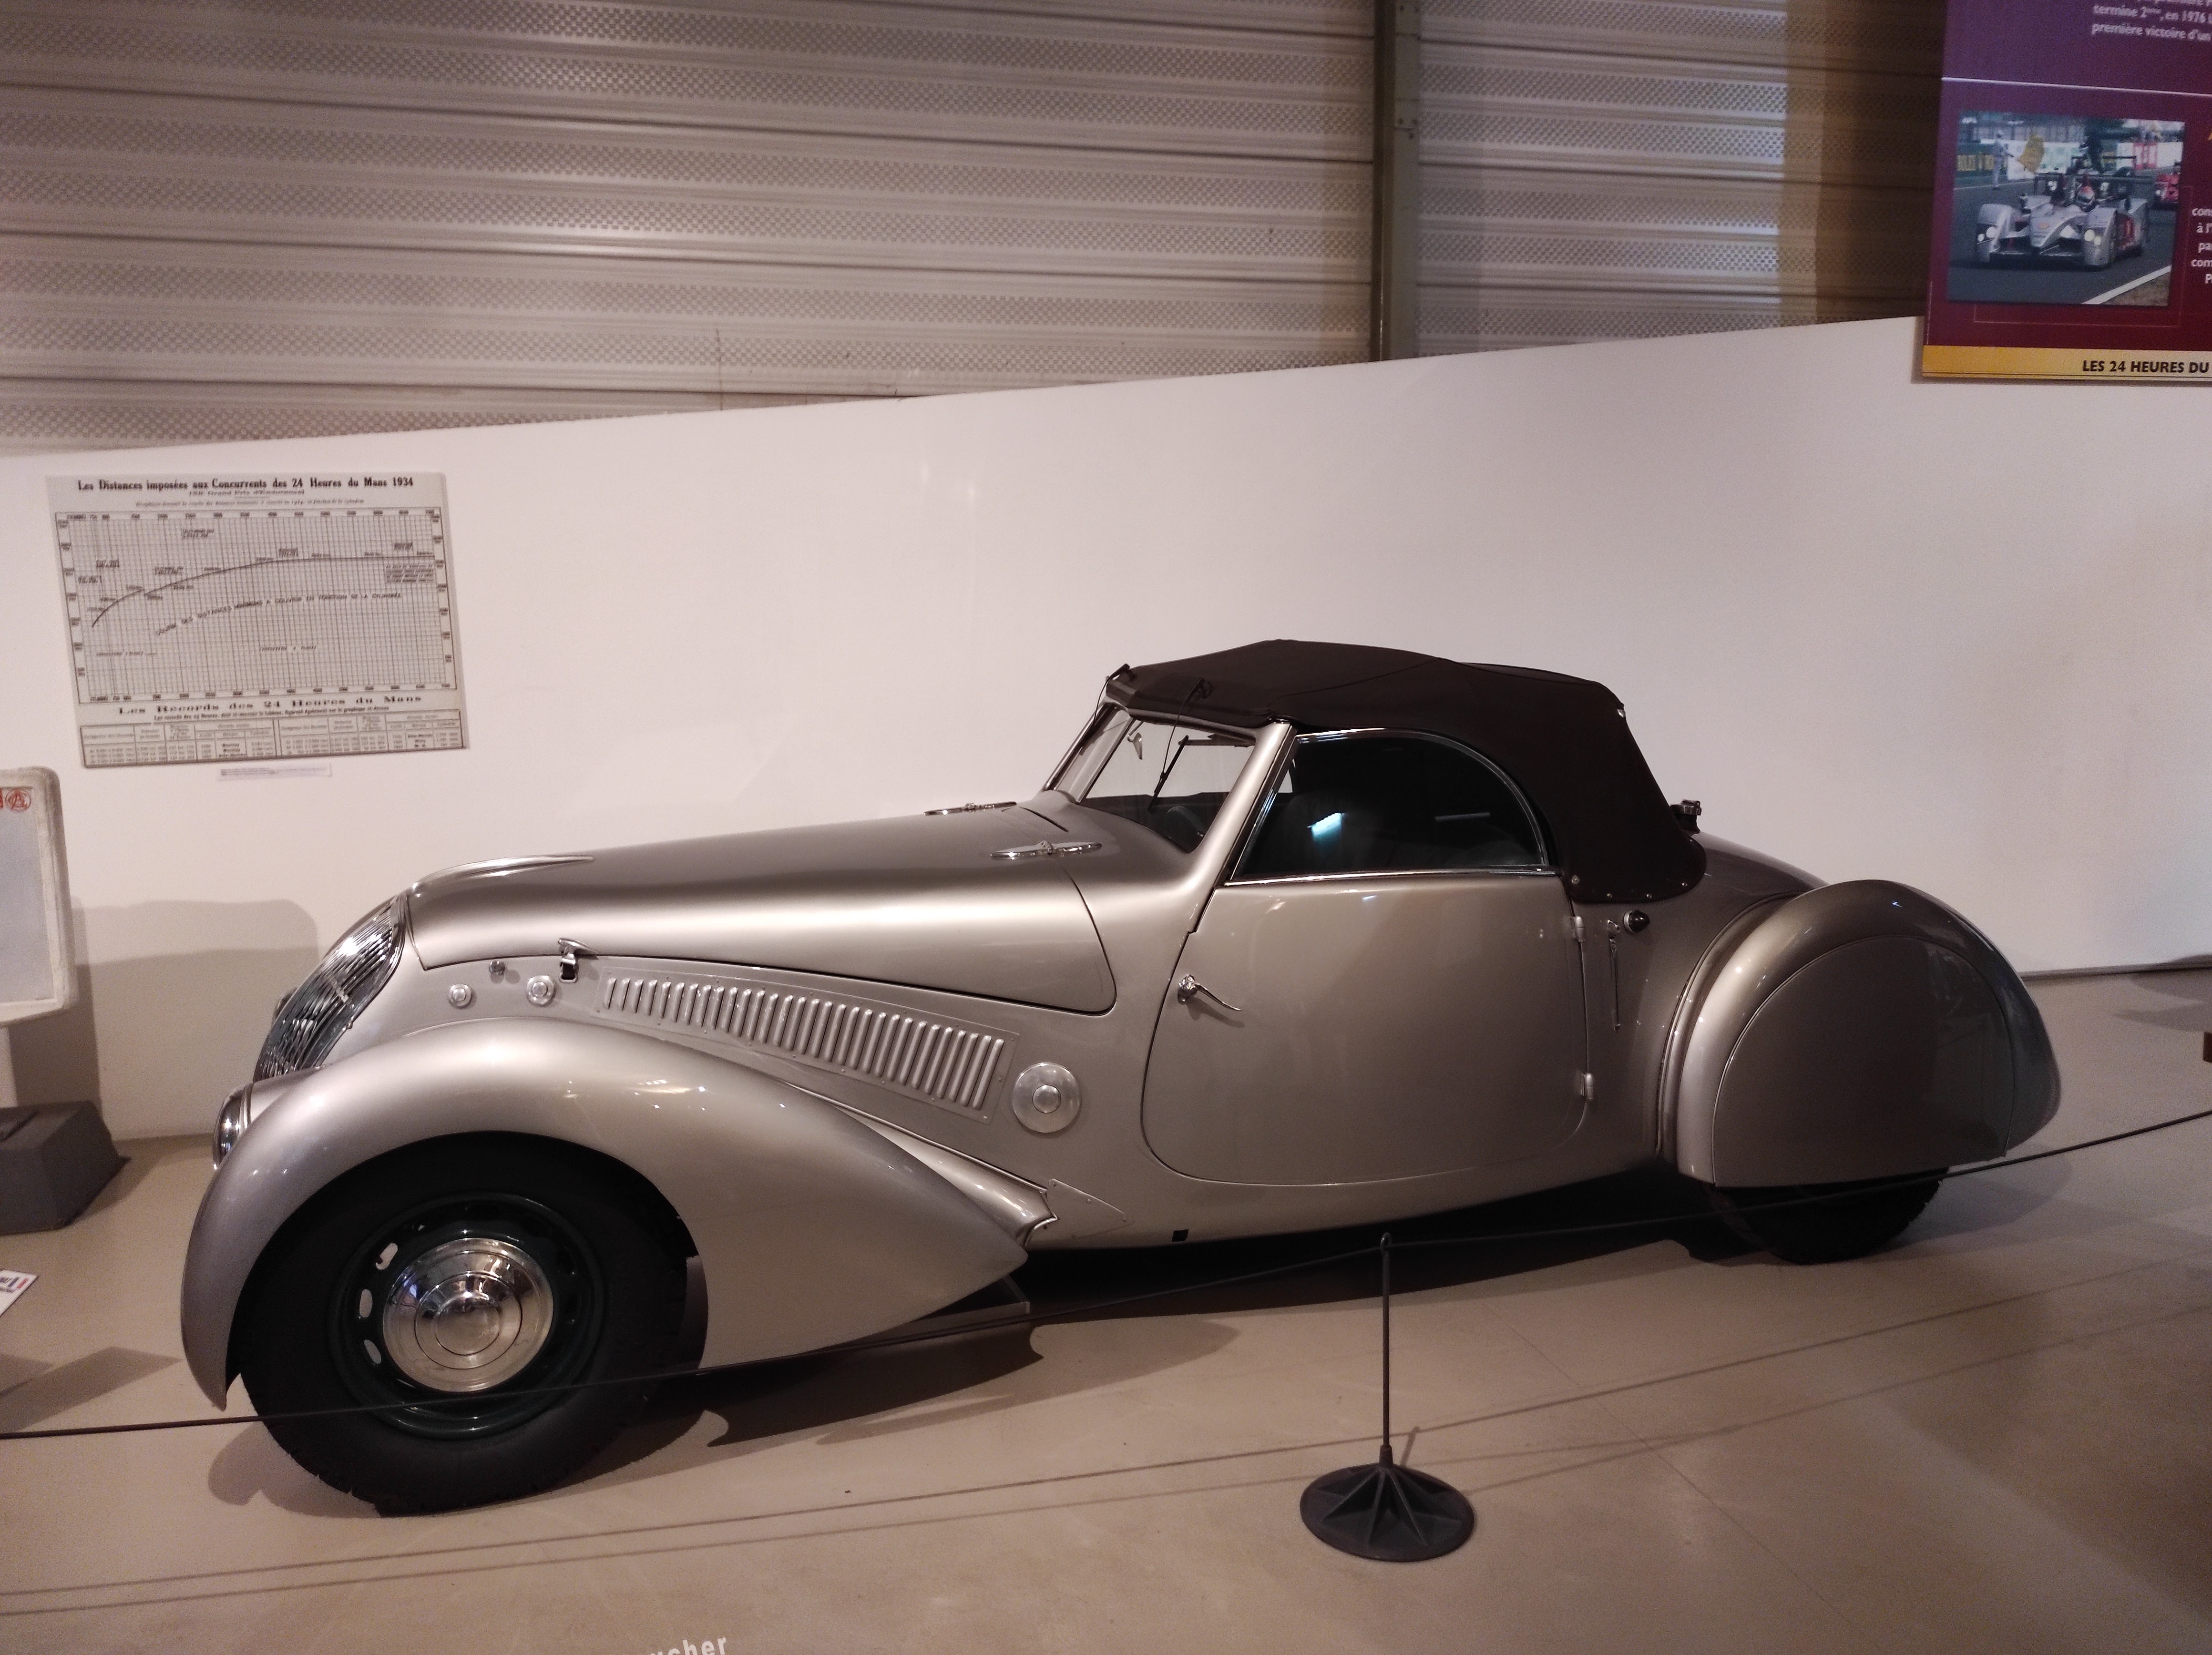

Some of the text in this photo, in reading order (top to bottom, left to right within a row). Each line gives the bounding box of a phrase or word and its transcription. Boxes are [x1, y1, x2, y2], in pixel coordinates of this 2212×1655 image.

[2182, 10, 2206, 23] 1976
[2091, 23, 2143, 36] première
[2082, 360, 2209, 373] LES 24 HEURES DU
[78, 480, 94, 490] Les
[99, 479, 143, 490] Distances
[146, 479, 188, 491] imposées
[212, 478, 267, 489] Concurrents
[273, 478, 287, 488] des
[292, 478, 303, 488] 24
[310, 477, 342, 487] Heures
[348, 477, 358, 487] du
[364, 477, 387, 487] Mans
[392, 477, 413, 487] 1934
[157, 703, 219, 713] Records
[292, 699, 345, 707] Heures
[650, 1637, 727, 1655] cher
